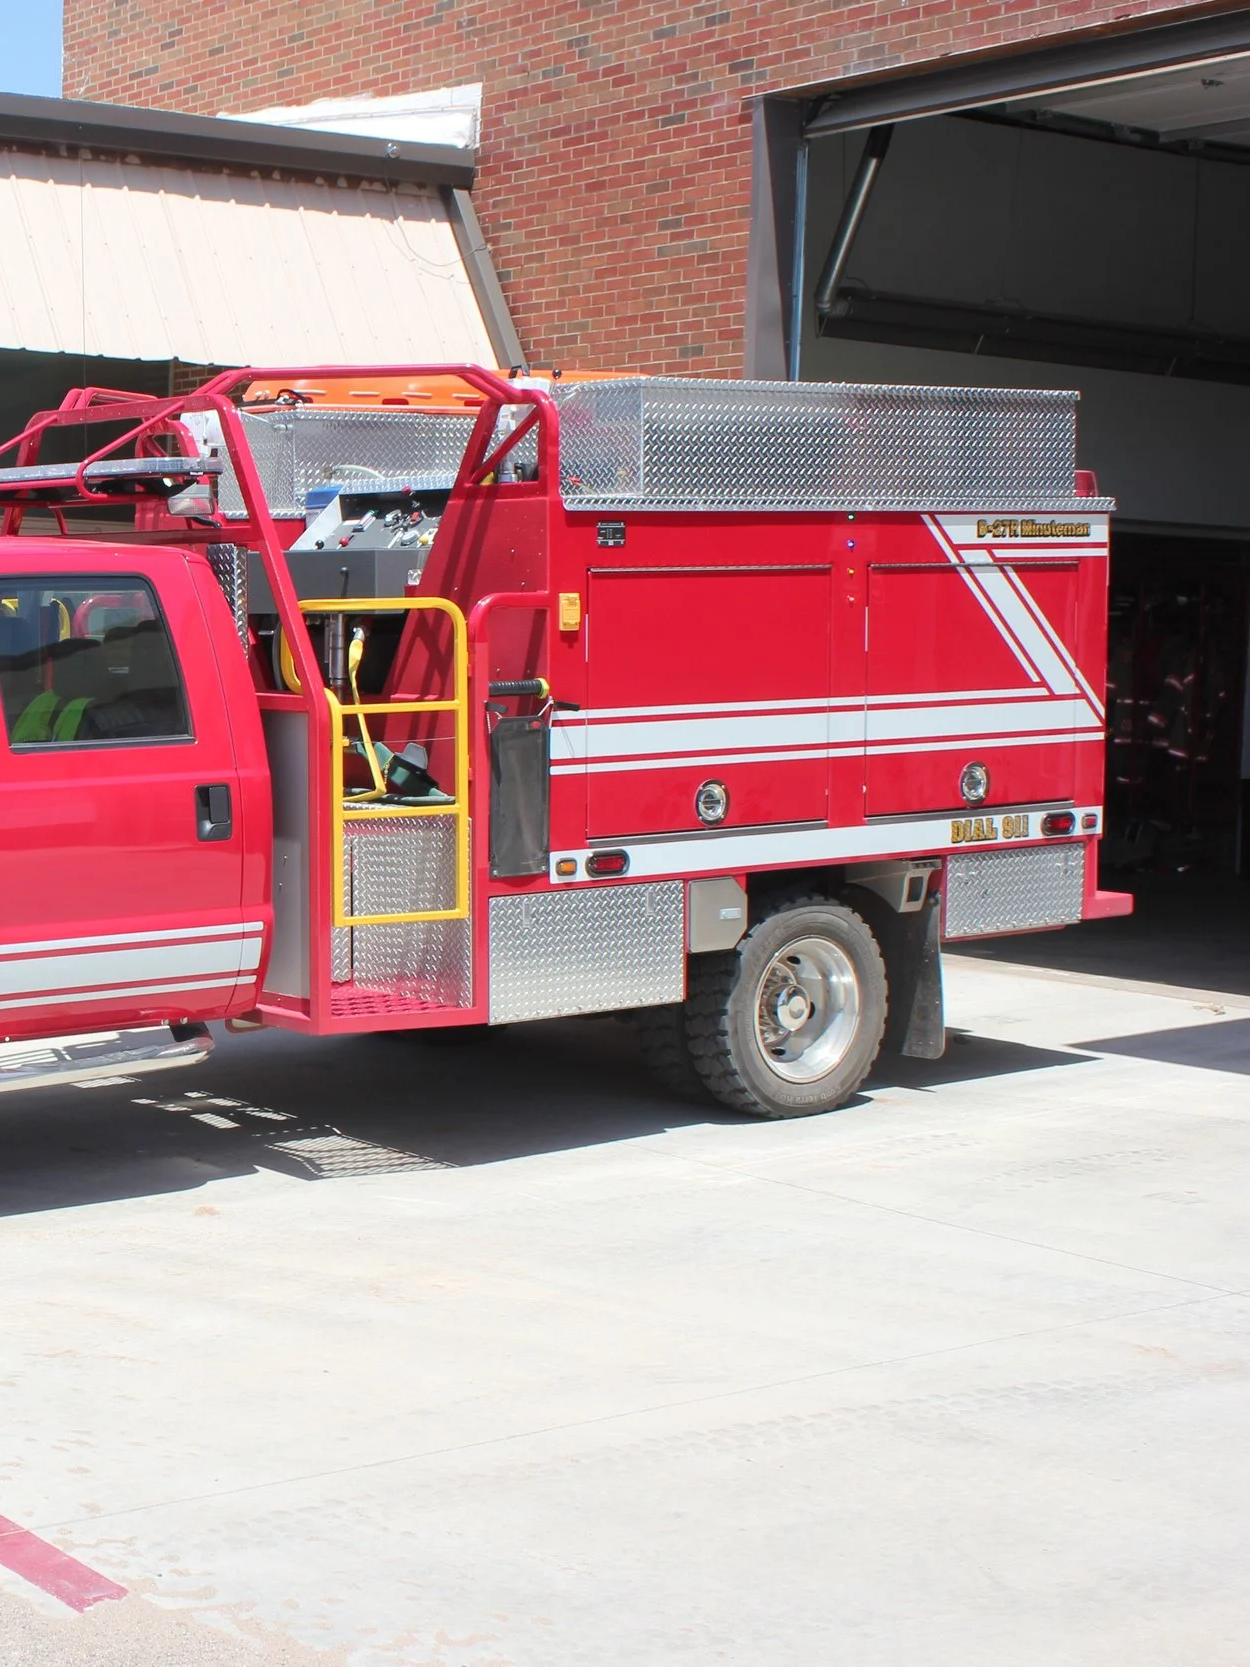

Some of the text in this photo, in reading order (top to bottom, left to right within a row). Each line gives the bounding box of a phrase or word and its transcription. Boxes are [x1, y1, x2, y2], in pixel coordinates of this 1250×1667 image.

[1020, 519, 1091, 538] Minuteman
[951, 814, 1029, 844] DIAL 911
